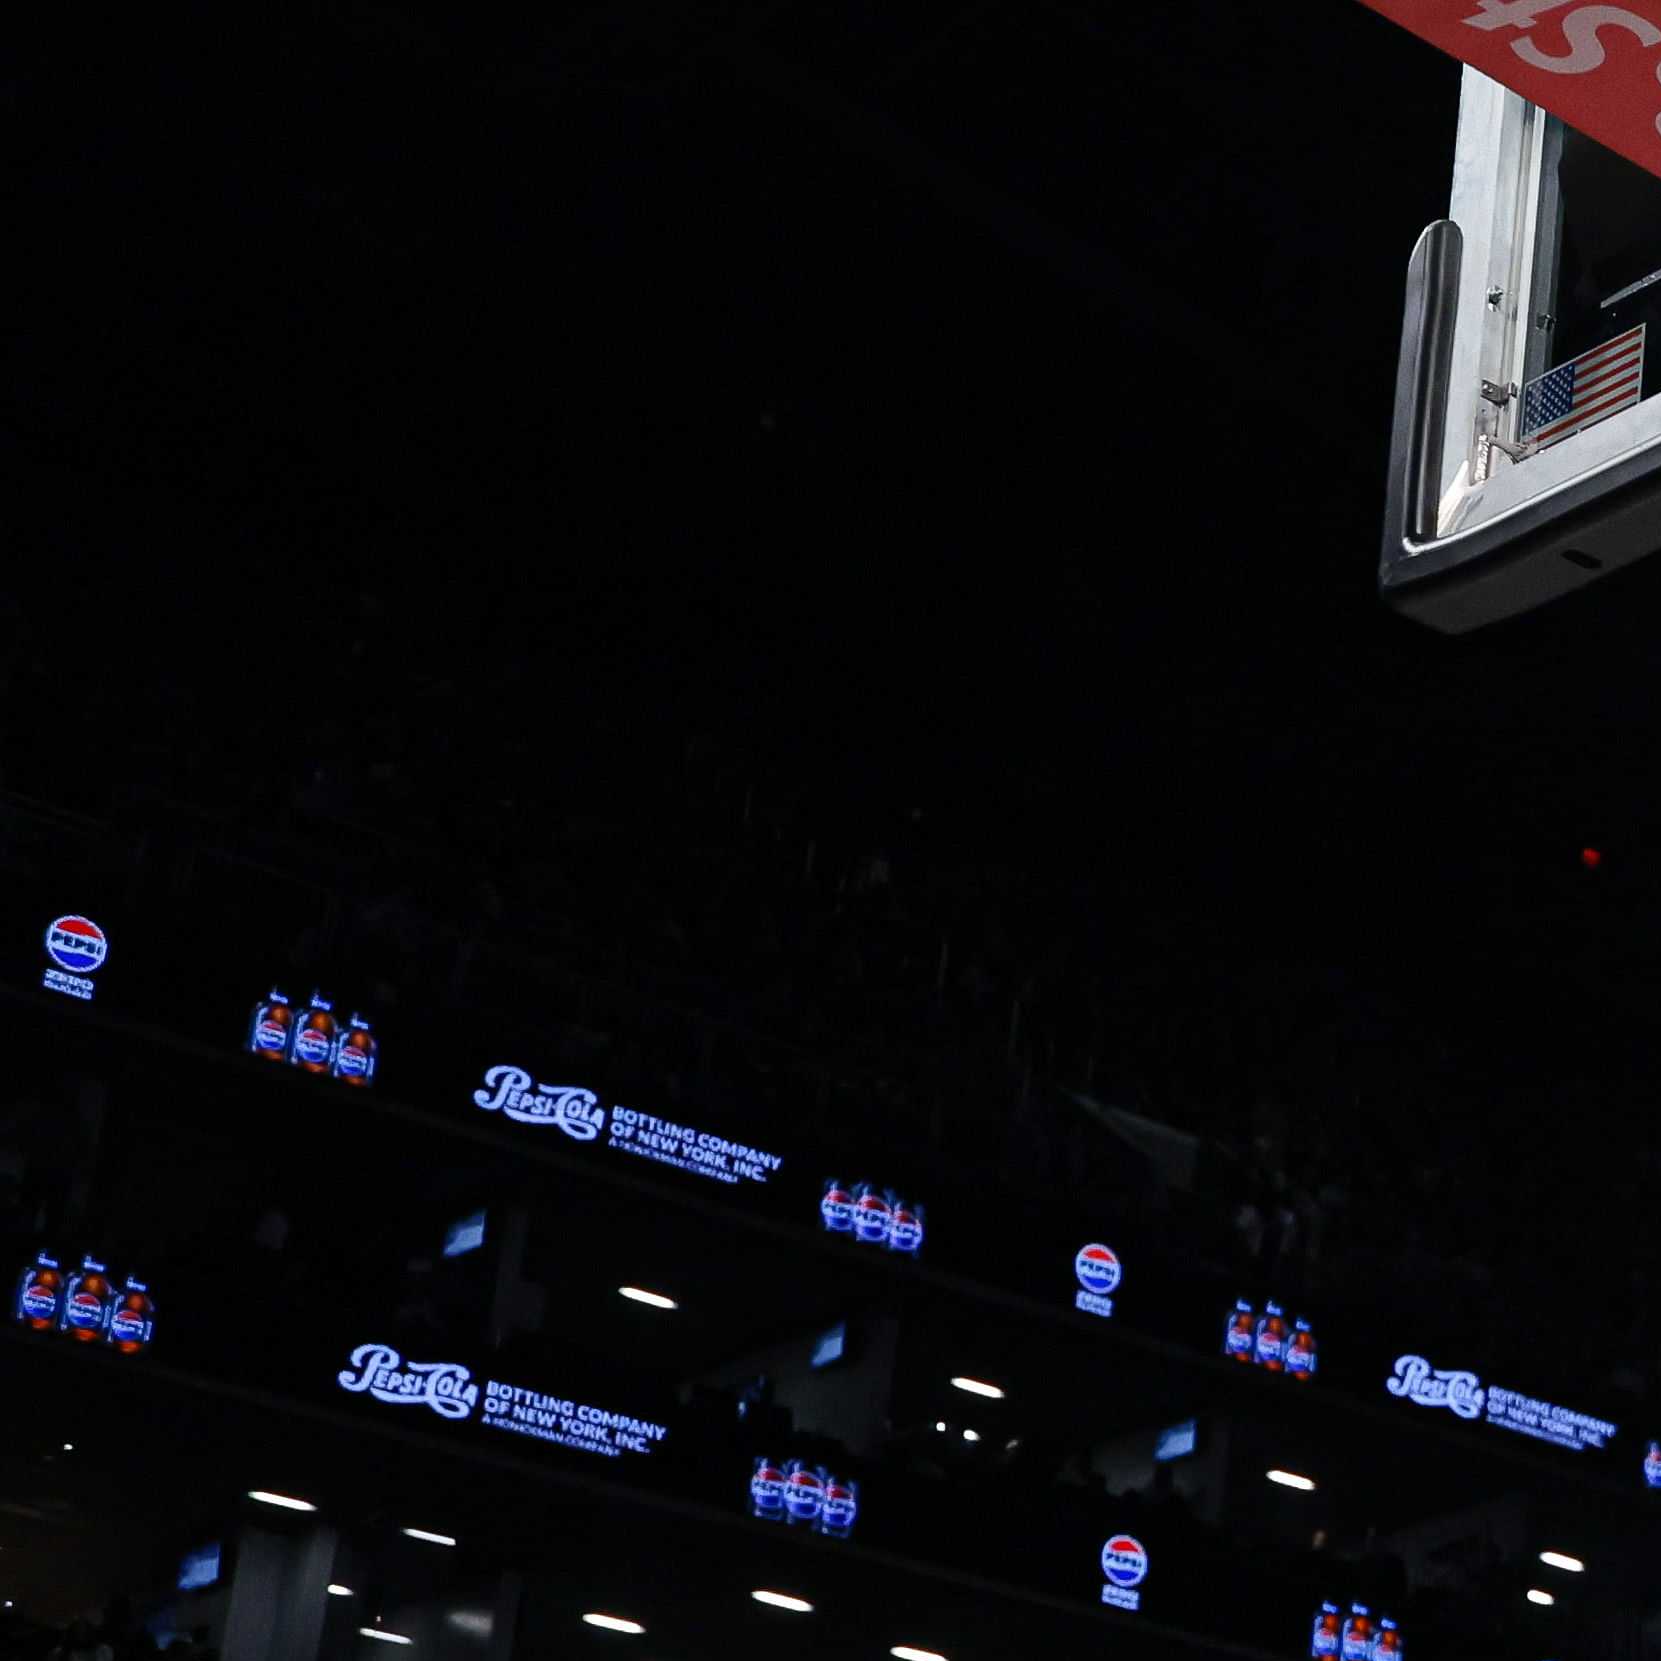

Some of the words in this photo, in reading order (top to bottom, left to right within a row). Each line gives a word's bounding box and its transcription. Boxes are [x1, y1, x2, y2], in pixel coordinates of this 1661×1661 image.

[610, 1121, 635, 1138] OF
[637, 1129, 677, 1153] NEW
[612, 1105, 694, 1142] BOTTLING
[697, 1133, 781, 1170] COMPANY
[484, 1397, 510, 1414] OF
[512, 1404, 556, 1428] NEW
[487, 1380, 574, 1416] BOTTLING
[577, 1405, 666, 1441] COMPANY
